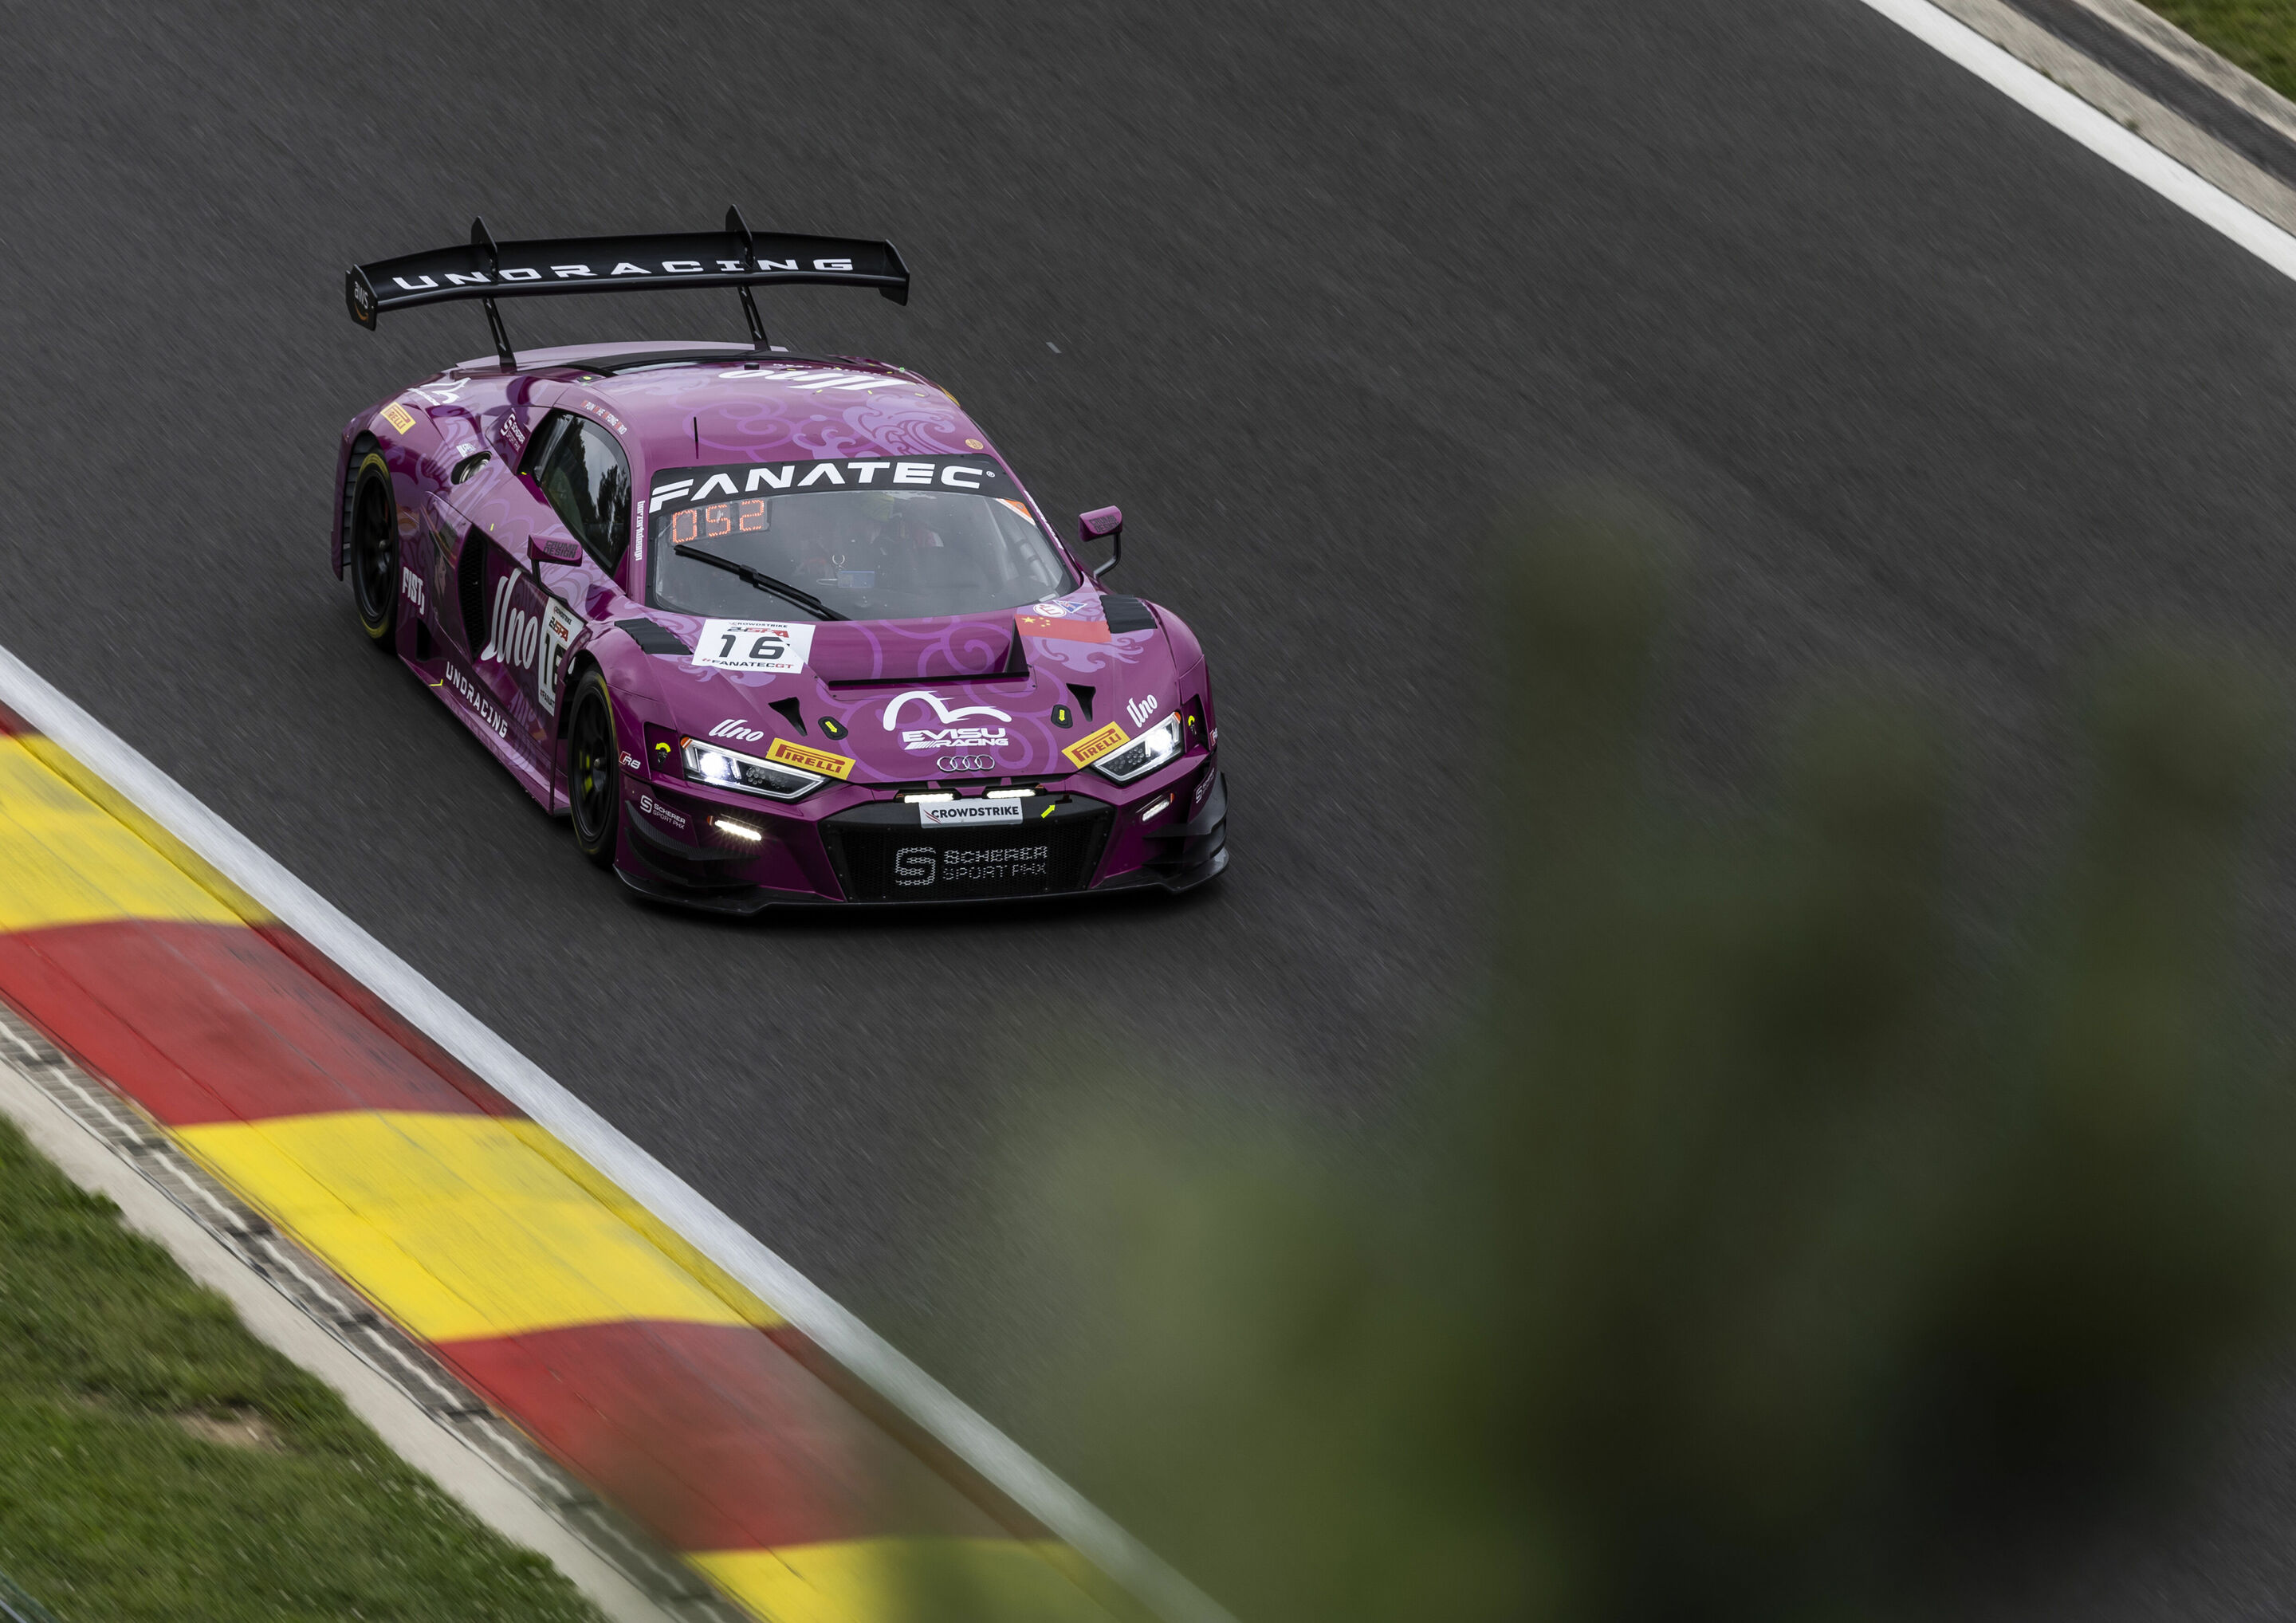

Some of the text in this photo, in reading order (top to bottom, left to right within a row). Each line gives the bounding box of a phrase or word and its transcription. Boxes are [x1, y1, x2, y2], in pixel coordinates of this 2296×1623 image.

[391, 257, 854, 290] UNORACING
[543, 547, 576, 558] DESIGN
[719, 635, 787, 659] 16
[446, 662, 508, 738] UNORACING
[902, 728, 1006, 742] EVISU
[931, 738, 1009, 749] RACING
[1071, 728, 1122, 762] PIRELLI
[623, 755, 641, 769] R8
[775, 744, 846, 773] PIRELLI
[653, 809, 672, 823] SPORT
[654, 804, 686, 824] SCHERER
[931, 806, 1019, 819] CROWDSTRIKE
